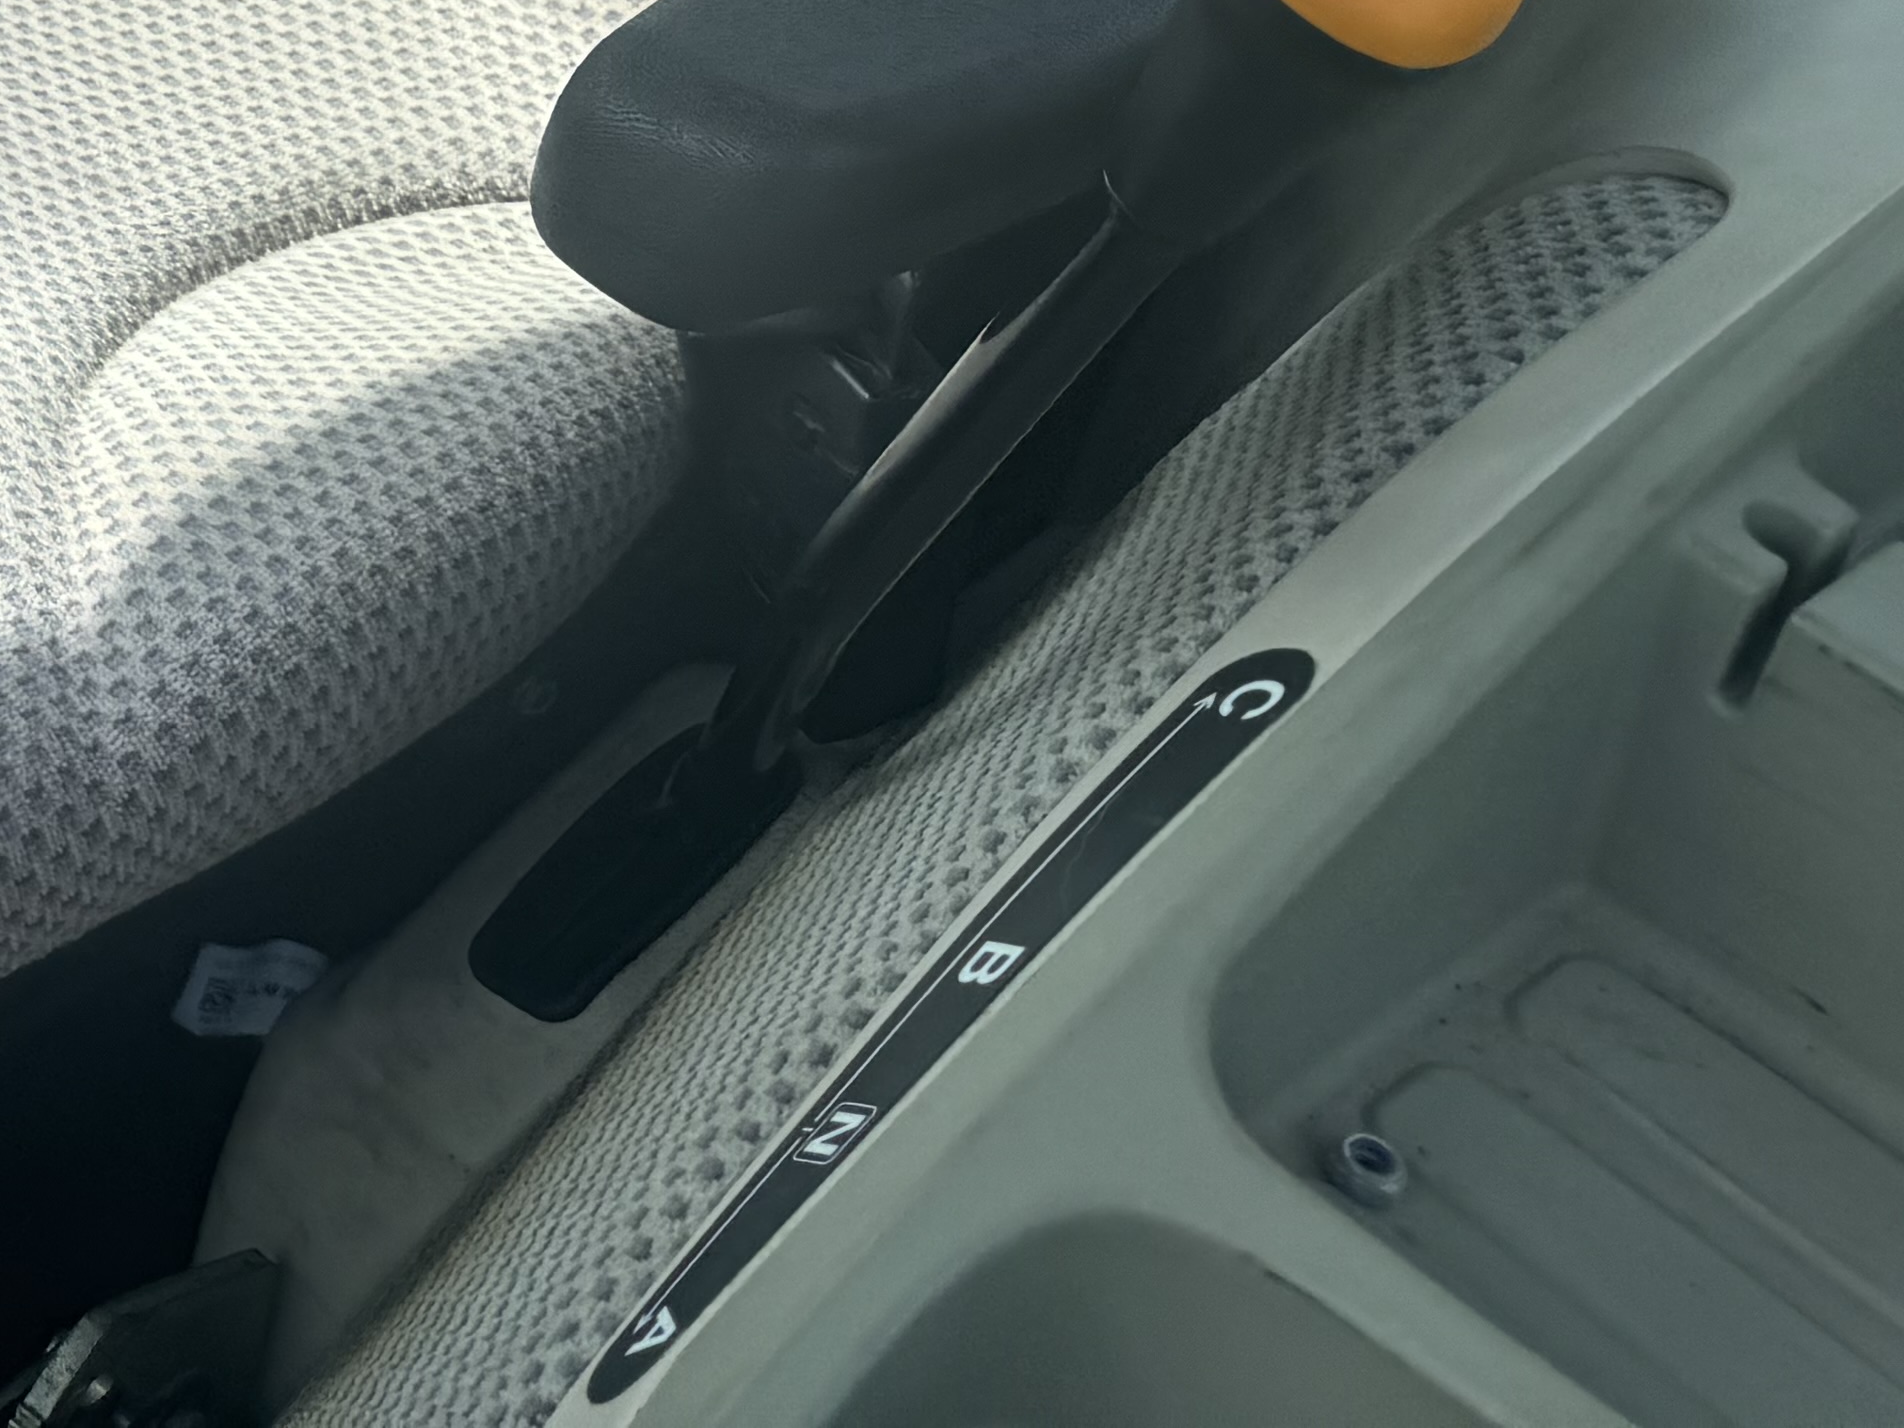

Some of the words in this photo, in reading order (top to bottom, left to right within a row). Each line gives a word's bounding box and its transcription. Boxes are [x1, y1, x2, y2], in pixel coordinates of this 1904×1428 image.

[1218, 679, 1286, 721] C
[957, 940, 1026, 985] B
[802, 1110, 867, 1157] N
[623, 1305, 677, 1357] A
